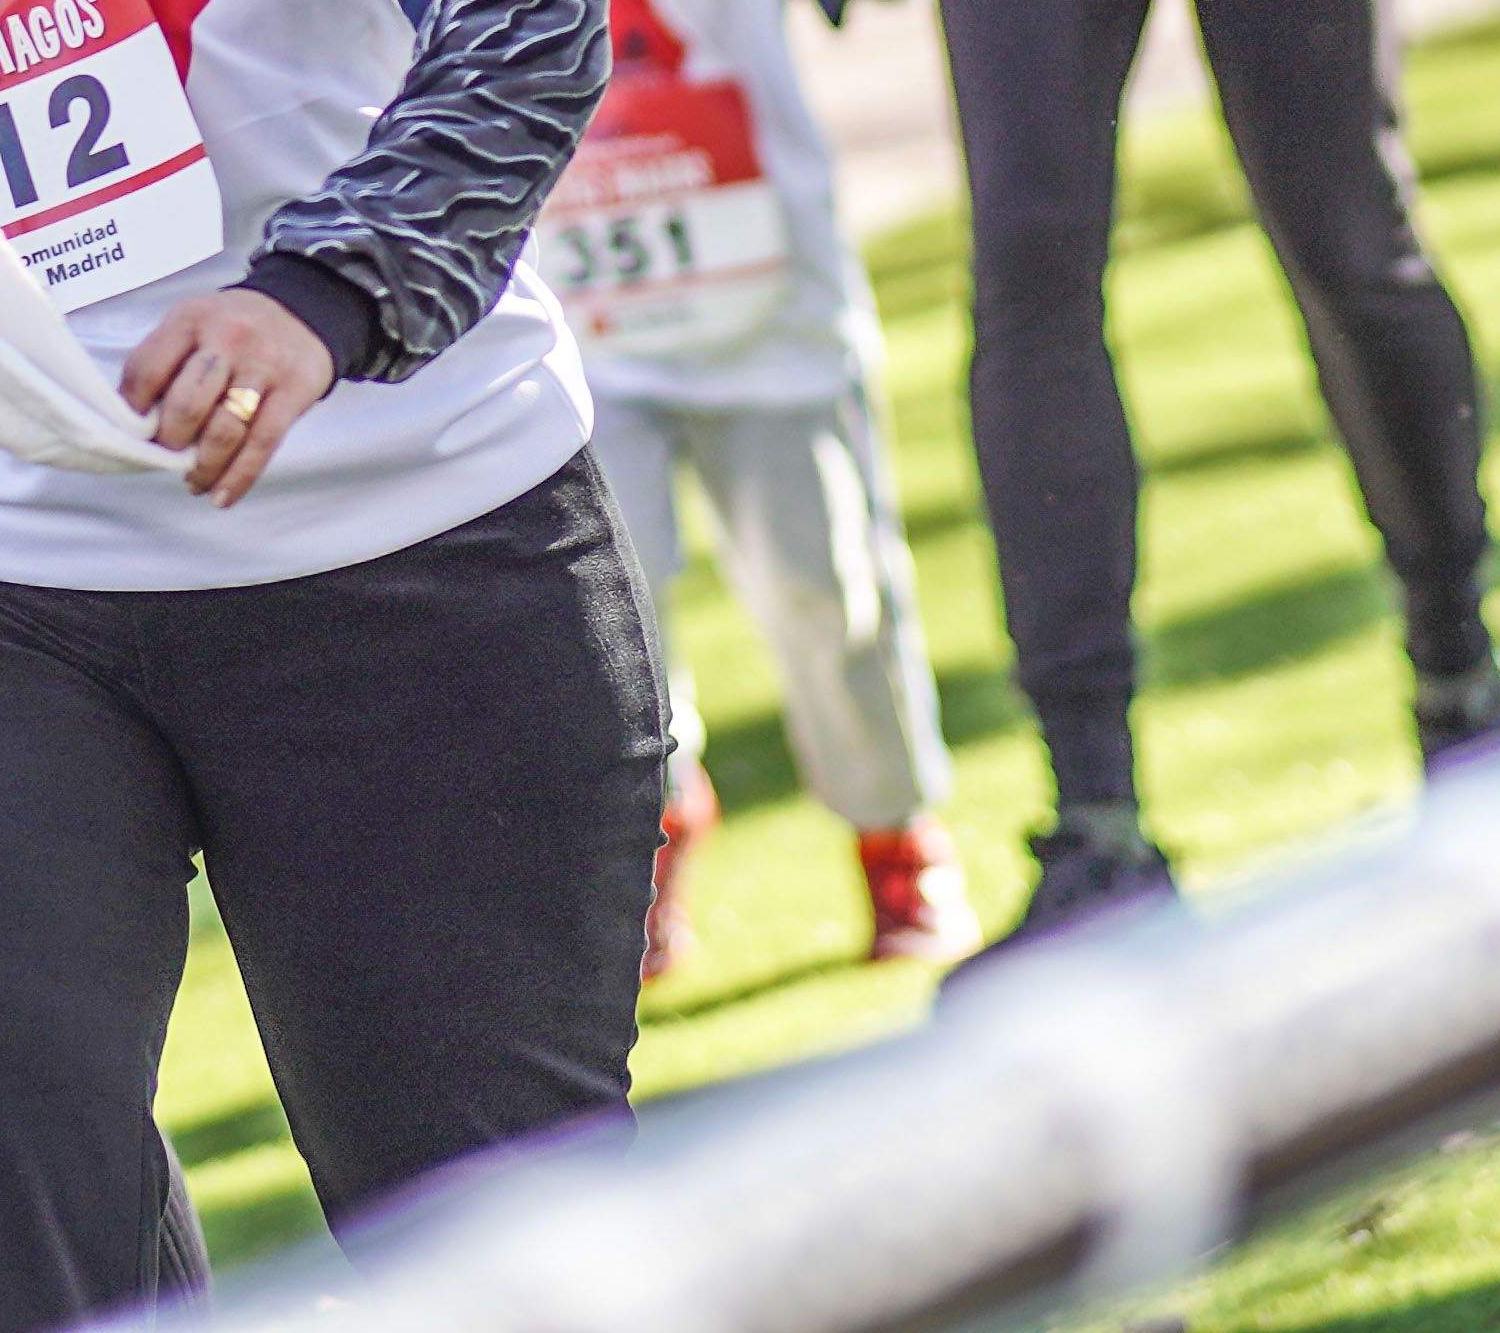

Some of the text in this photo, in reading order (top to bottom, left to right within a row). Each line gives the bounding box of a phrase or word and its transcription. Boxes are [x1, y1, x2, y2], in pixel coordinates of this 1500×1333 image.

[21, 219, 118, 267] omunidad
[46, 243, 125, 285] Madrid
[558, 214, 693, 288] 351
